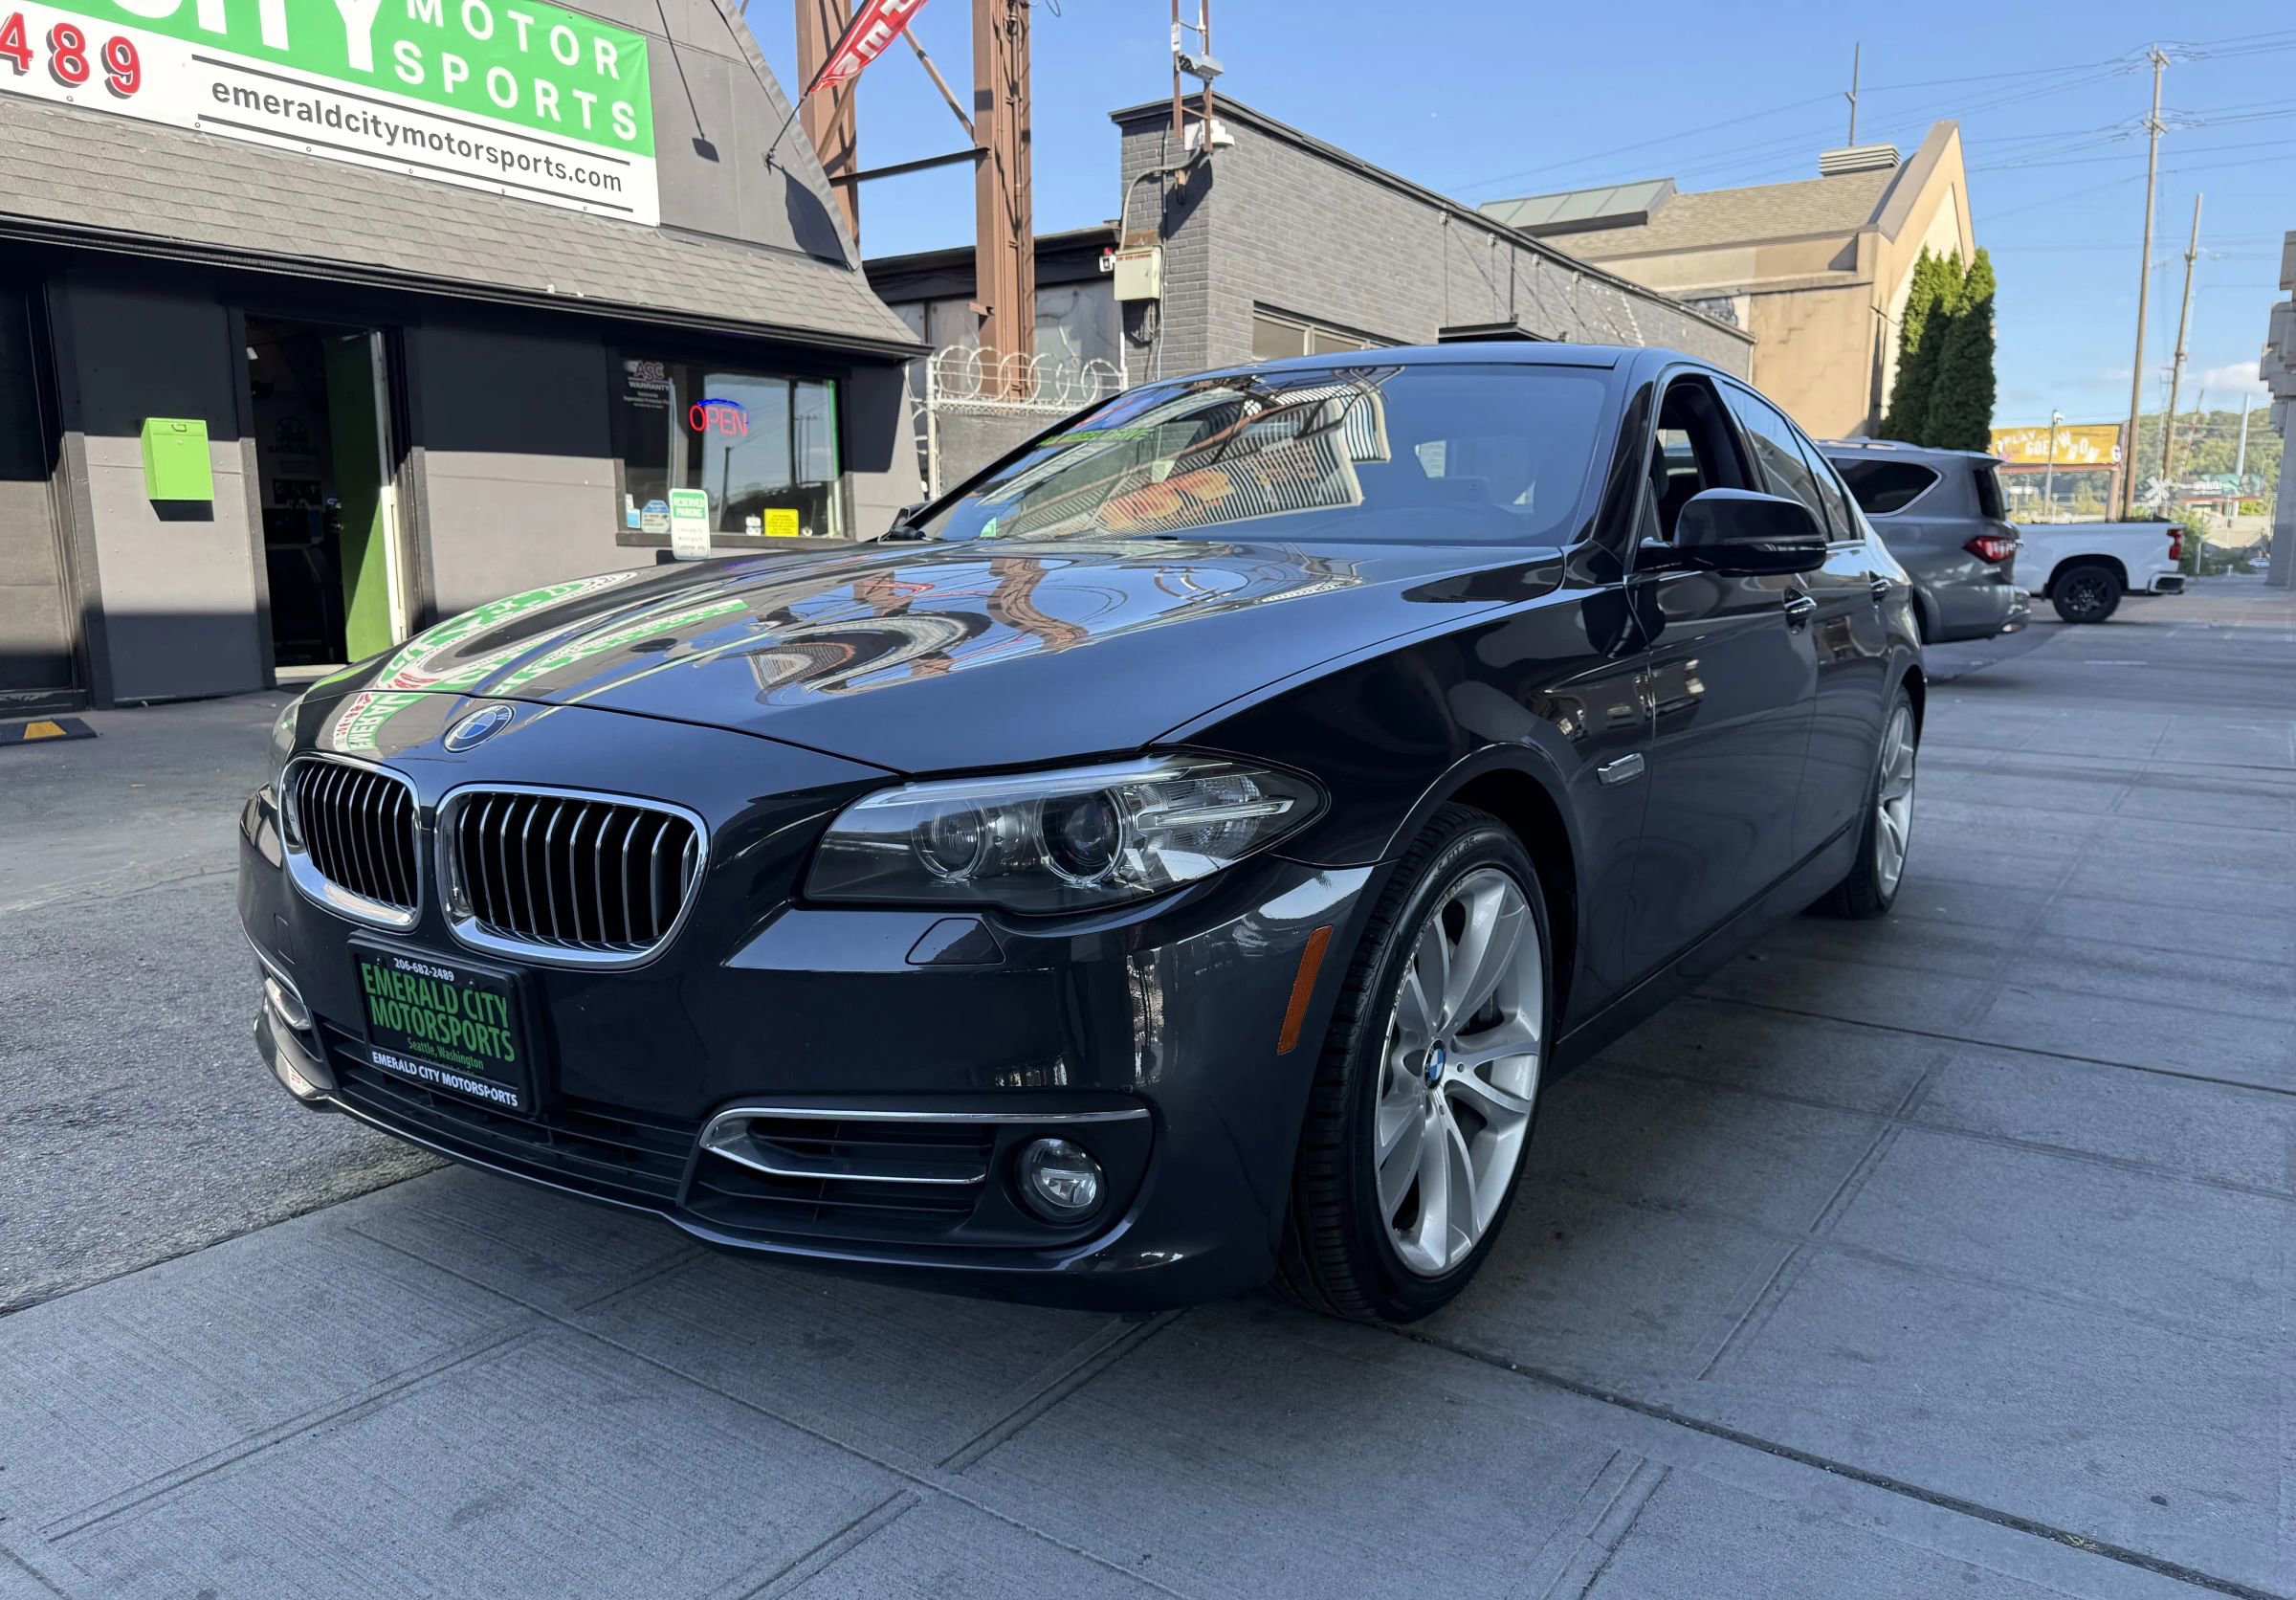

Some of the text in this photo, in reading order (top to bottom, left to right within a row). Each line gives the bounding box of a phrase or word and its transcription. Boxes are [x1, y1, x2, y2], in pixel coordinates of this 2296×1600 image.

[0, 11, 142, 99] 489
[407, 0, 620, 79] MOTOR
[393, 40, 637, 142] SPORTS
[211, 81, 622, 192] emeraldcitymotorsports.com
[689, 404, 748, 437] OPEN
[361, 962, 509, 1029] EMERALD CITY
[393, 957, 454, 982] 206-682-2489
[369, 996, 517, 1063] MOTORSPORTS
[407, 1037, 438, 1057] Seattle,
[437, 1045, 484, 1071] Washington
[372, 1051, 417, 1076] EMERALD
[418, 1065, 441, 1082] CITY
[441, 1073, 519, 1107] MOTORSPORTS
